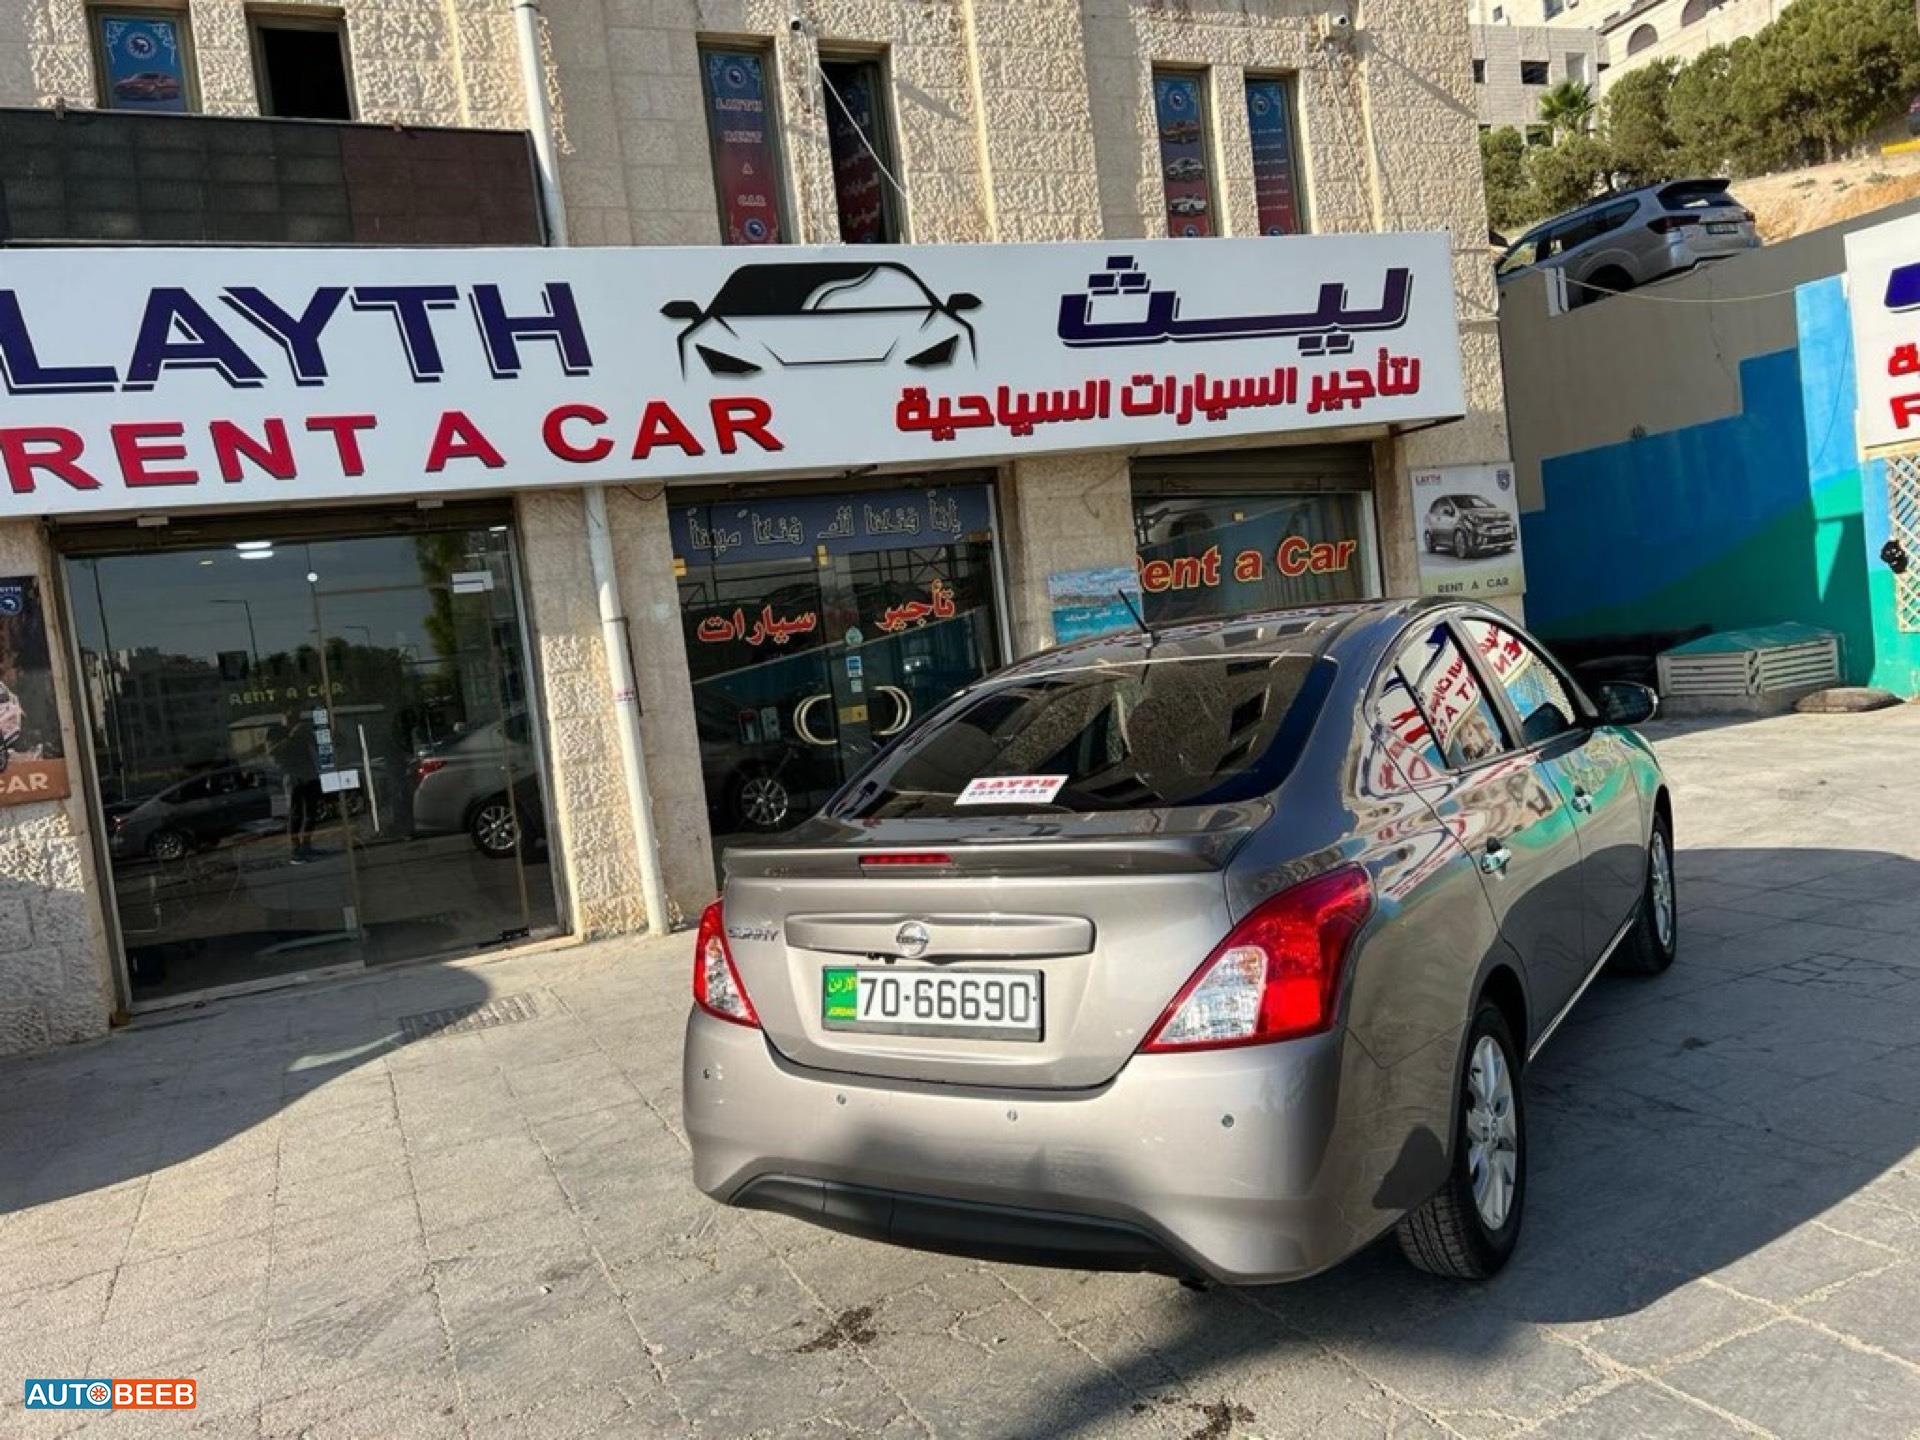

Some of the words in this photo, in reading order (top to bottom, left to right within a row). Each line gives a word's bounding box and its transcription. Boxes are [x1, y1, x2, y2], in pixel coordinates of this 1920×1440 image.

[1057, 254, 1413, 356] ليث
[0, 282, 593, 396] LAYTH
[896, 379, 1111, 441] السياحية
[1120, 366, 1298, 425] السيارات
[1307, 347, 1421, 413] لتأجير
[0, 414, 377, 494] RENT
[425, 411, 507, 472] A
[541, 398, 784, 466] CAR
[1136, 545, 1222, 594] ent
[1234, 550, 1263, 583] a
[1276, 535, 1357, 577] Car
[1437, 582, 1463, 594] RENT
[1471, 580, 1479, 590] A
[1486, 576, 1509, 588] CAR
[698, 604, 817, 646] سيارات
[875, 579, 956, 632] تأجير
